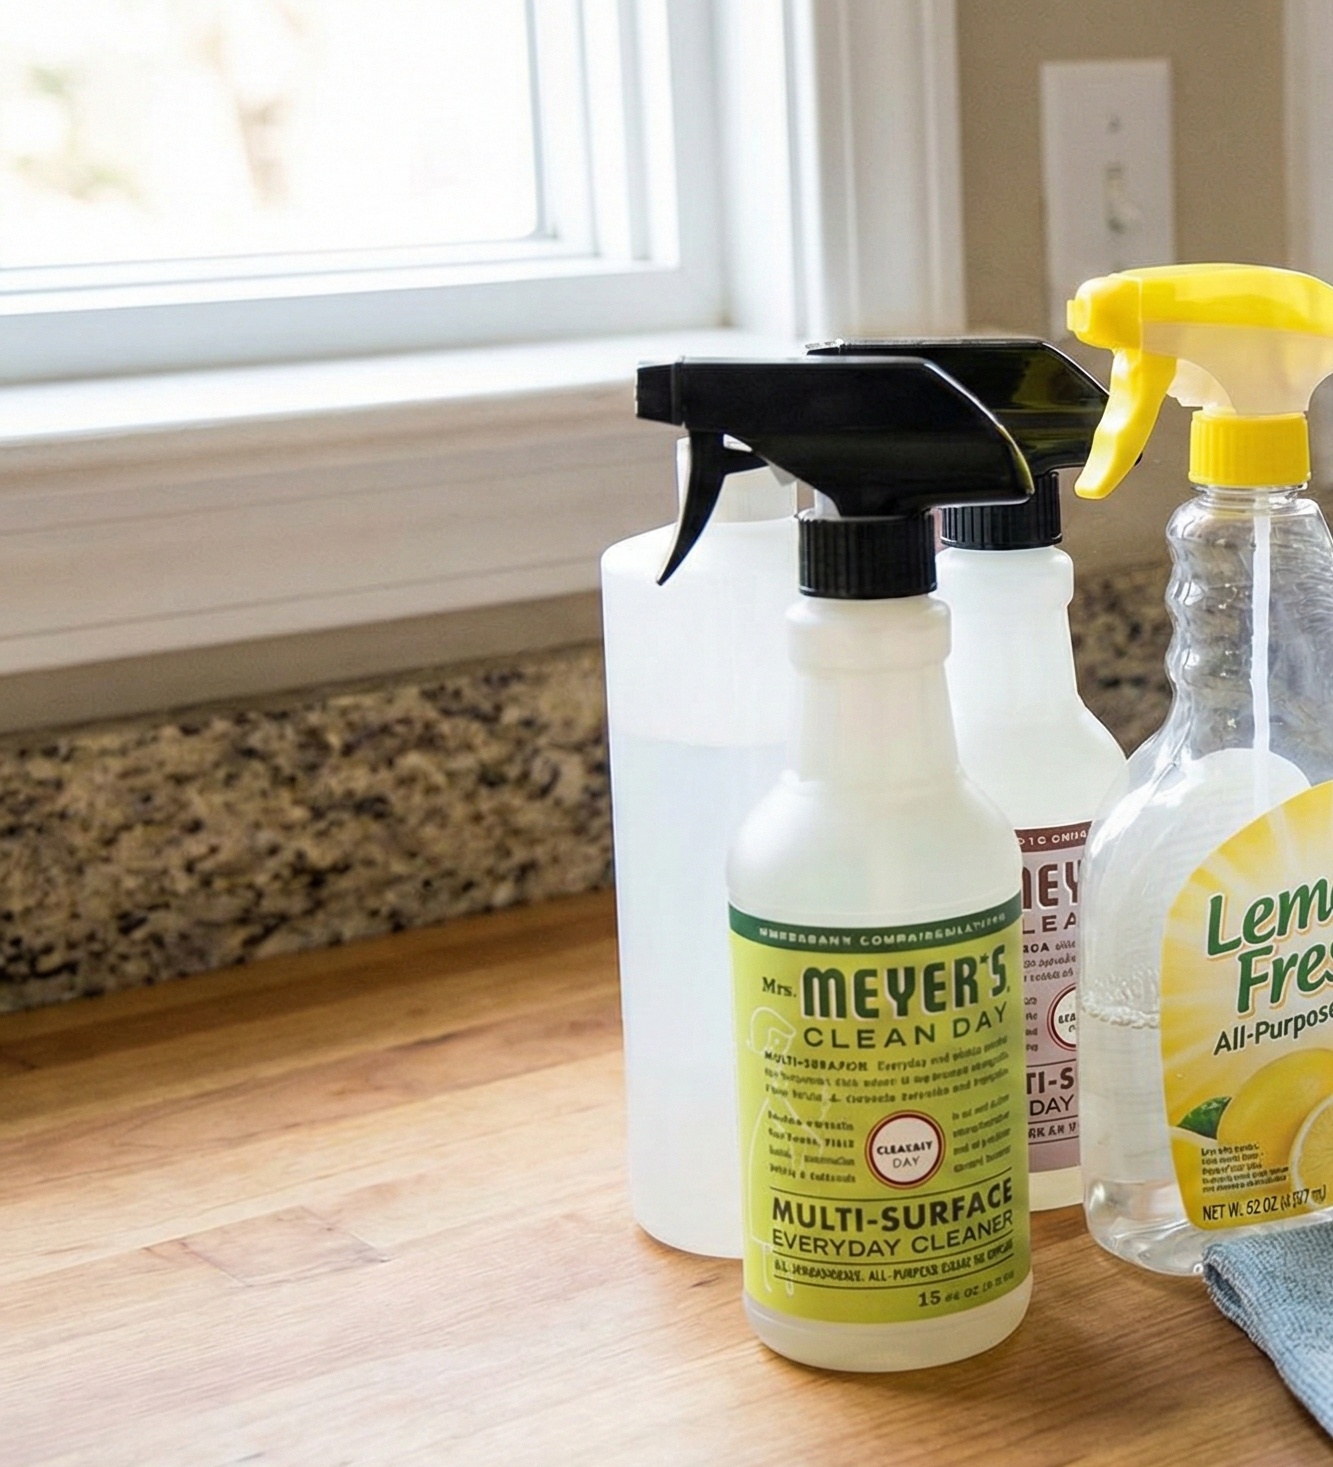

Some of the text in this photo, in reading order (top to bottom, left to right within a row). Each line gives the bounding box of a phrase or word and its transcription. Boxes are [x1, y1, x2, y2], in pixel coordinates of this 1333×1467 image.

[762, 977, 797, 997] Mrs.
[803, 1023, 936, 1048] CLEAN
[952, 1001, 1007, 1039] DAY
[1029, 1094, 1074, 1117] DAY
[893, 1156, 920, 1169] DAY
[773, 1177, 1012, 1232] MULTI-SURFACE
[1203, 1204, 1226, 1221] NET
[772, 1229, 902, 1258] EVERYDAY
[911, 1209, 1013, 1254] CLEANER
[918, 1290, 941, 1307] 15
